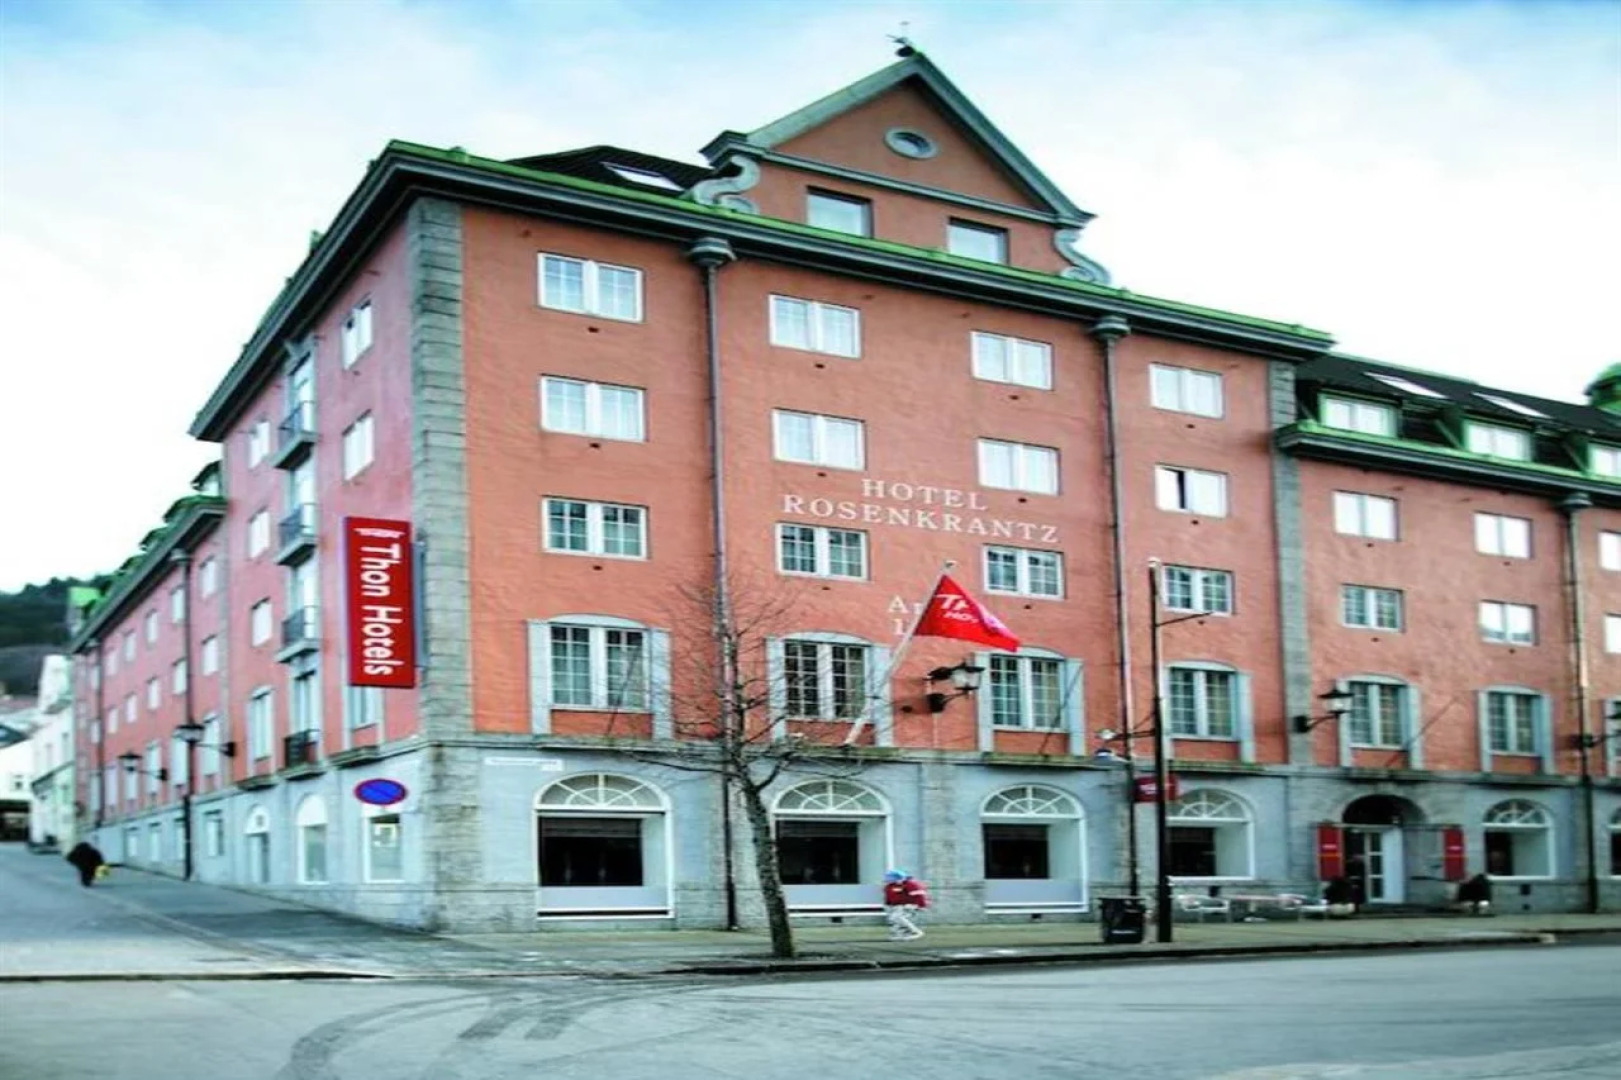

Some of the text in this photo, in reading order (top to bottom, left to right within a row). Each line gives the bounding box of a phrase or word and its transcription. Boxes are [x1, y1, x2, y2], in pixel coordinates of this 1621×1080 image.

[783, 494, 1060, 543] ROSENKRANTZ
[862, 478, 988, 511] HOTEL
[361, 543, 404, 676] Thon Hotels
